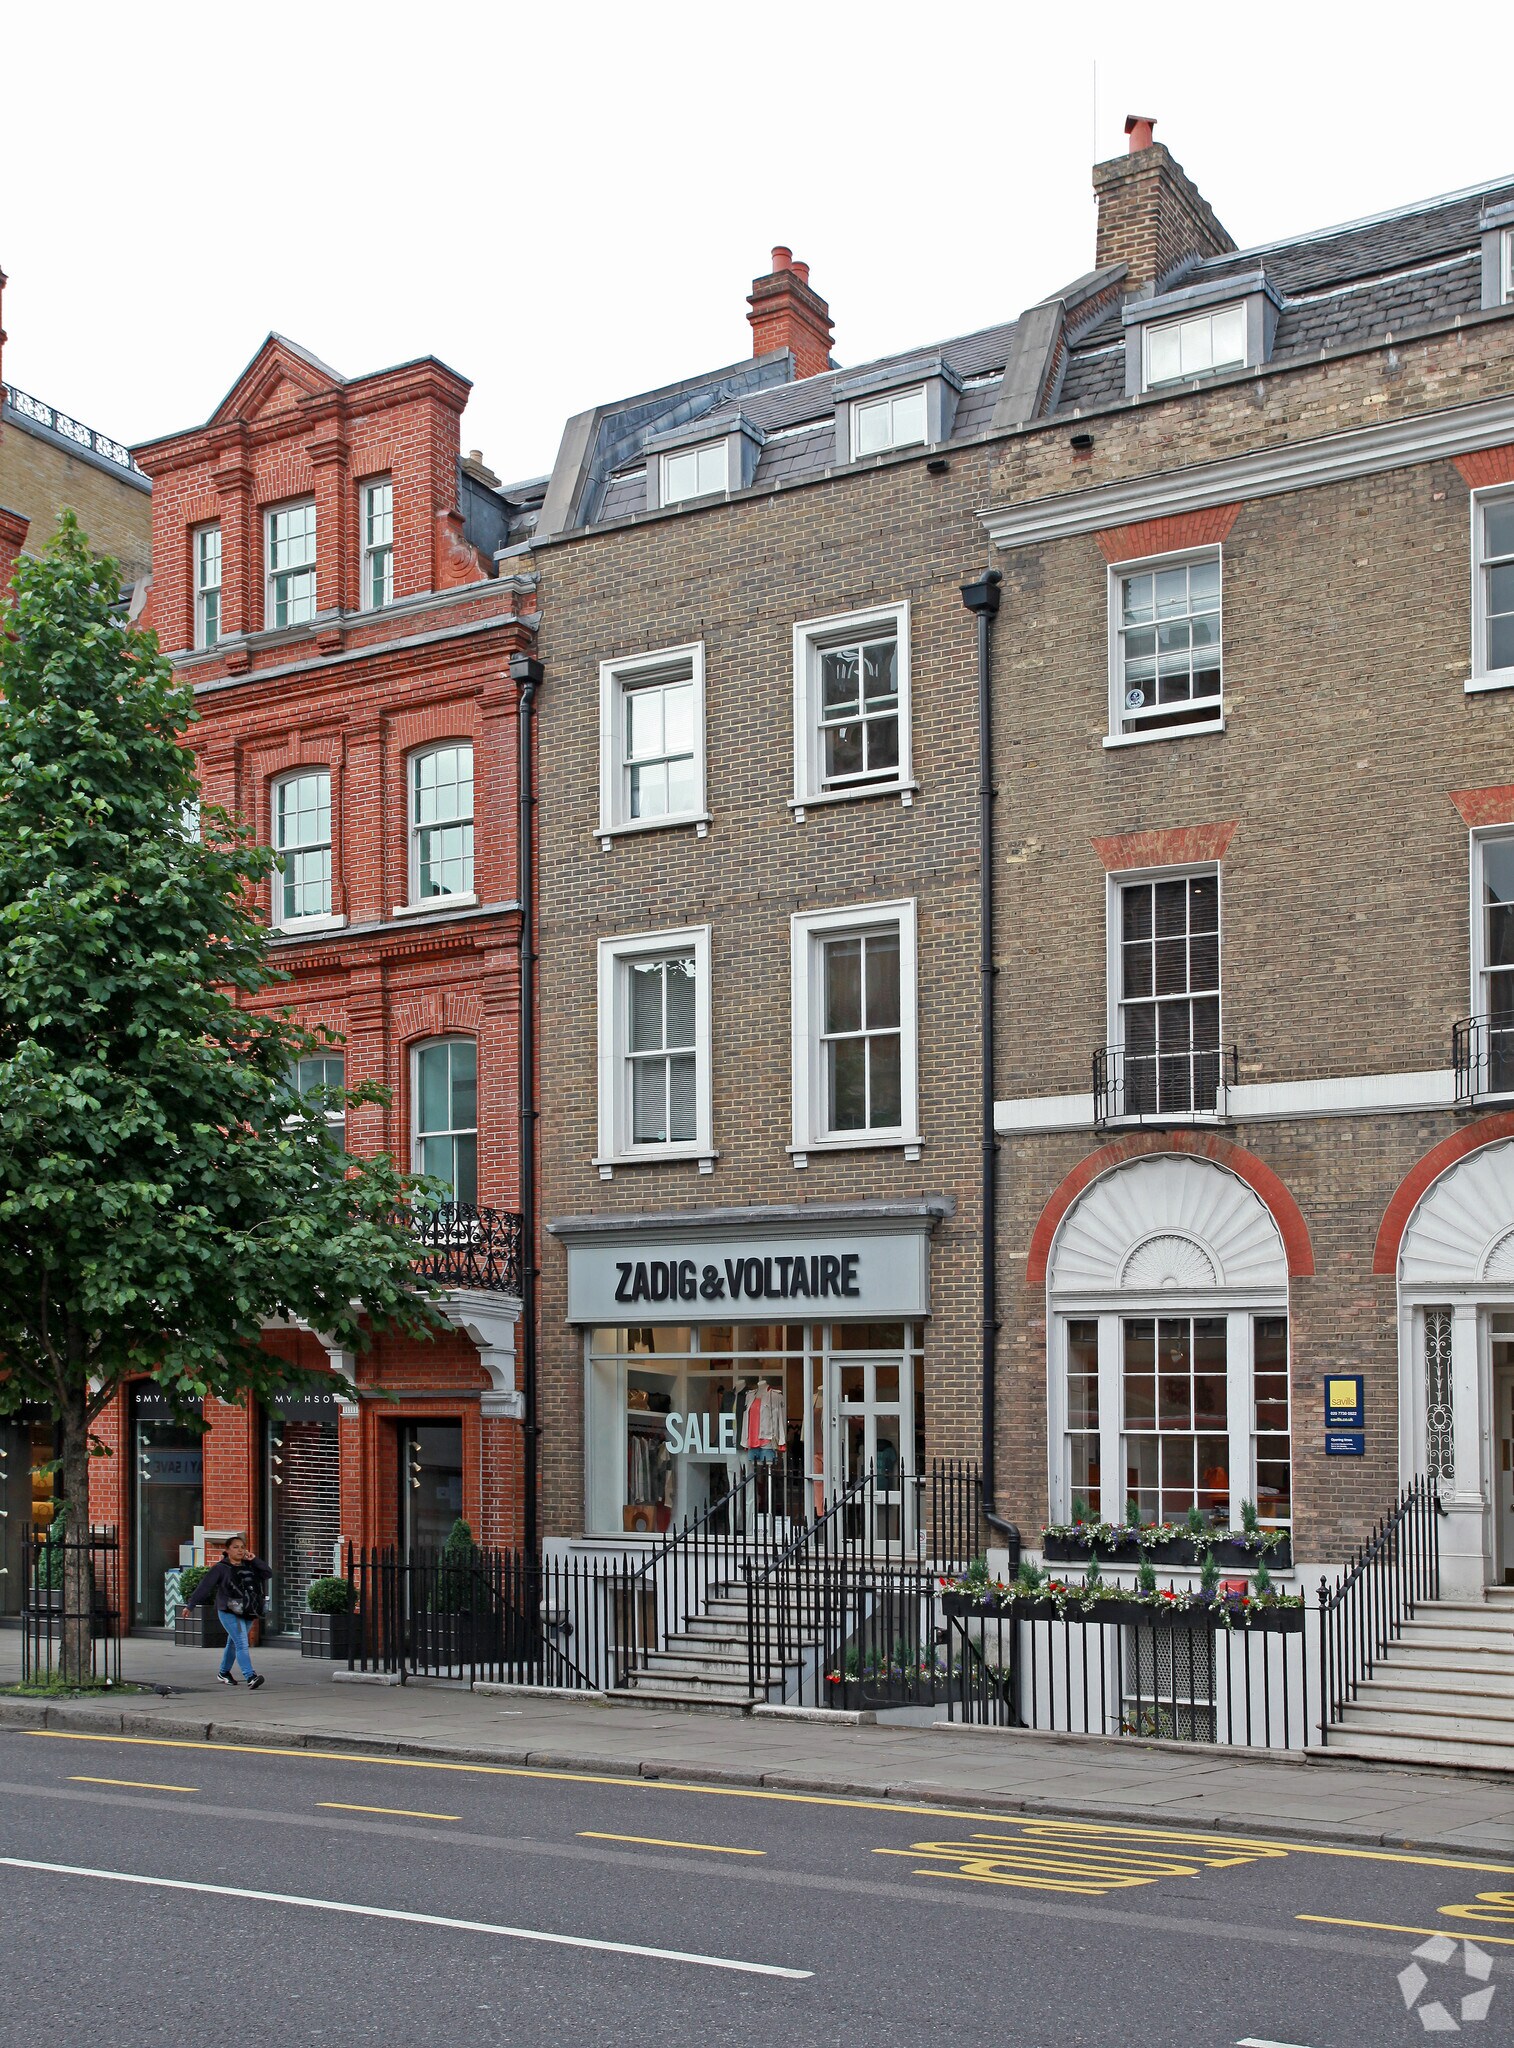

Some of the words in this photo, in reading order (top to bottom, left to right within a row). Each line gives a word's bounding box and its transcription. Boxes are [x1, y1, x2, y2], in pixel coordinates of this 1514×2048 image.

[615, 1254, 860, 1301] ZADIG&VOLTAIRE
[1332, 1397, 1355, 1406] savills
[665, 1412, 737, 1454] SALE
